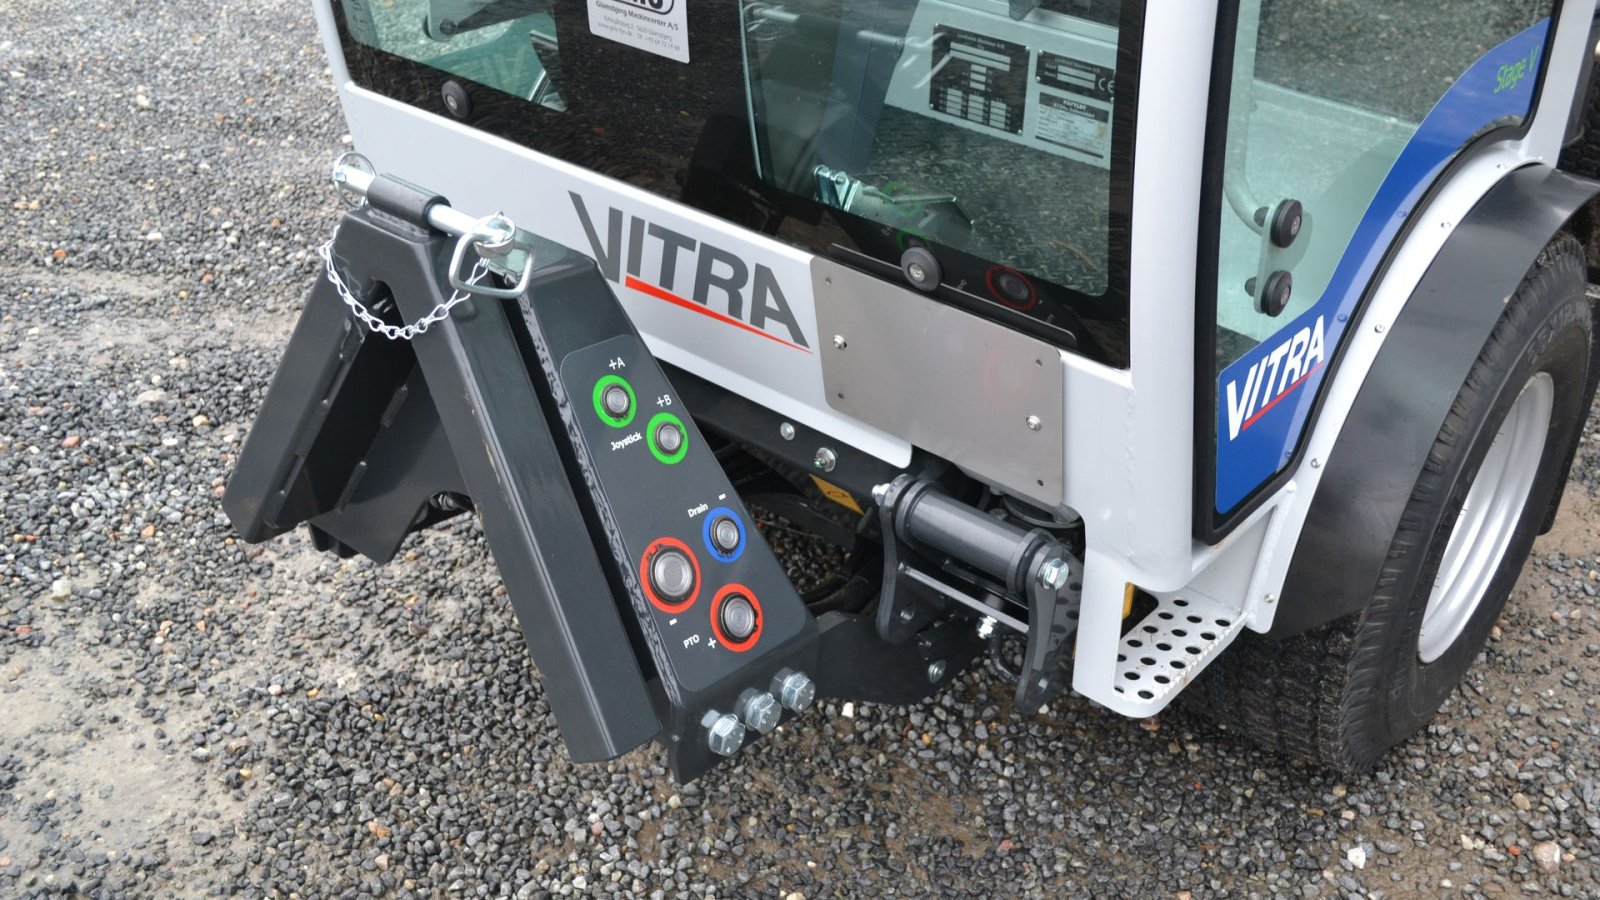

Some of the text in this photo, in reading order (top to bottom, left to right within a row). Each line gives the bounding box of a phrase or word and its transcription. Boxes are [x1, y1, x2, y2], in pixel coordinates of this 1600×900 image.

[595, 0, 627, 16] Glamsbjerg
[628, 10, 666, 27] Maskincenter
[667, 23, 679, 31] A/S
[1494, 45, 1540, 93] Stage V
[568, 190, 811, 350] VITRA
[608, 357, 626, 370] +A
[1226, 314, 1324, 442] VITRA
[656, 394, 672, 407] +B
[610, 431, 642, 451] Joystick
[687, 503, 709, 518] Drain
[683, 634, 700, 649] PTO
